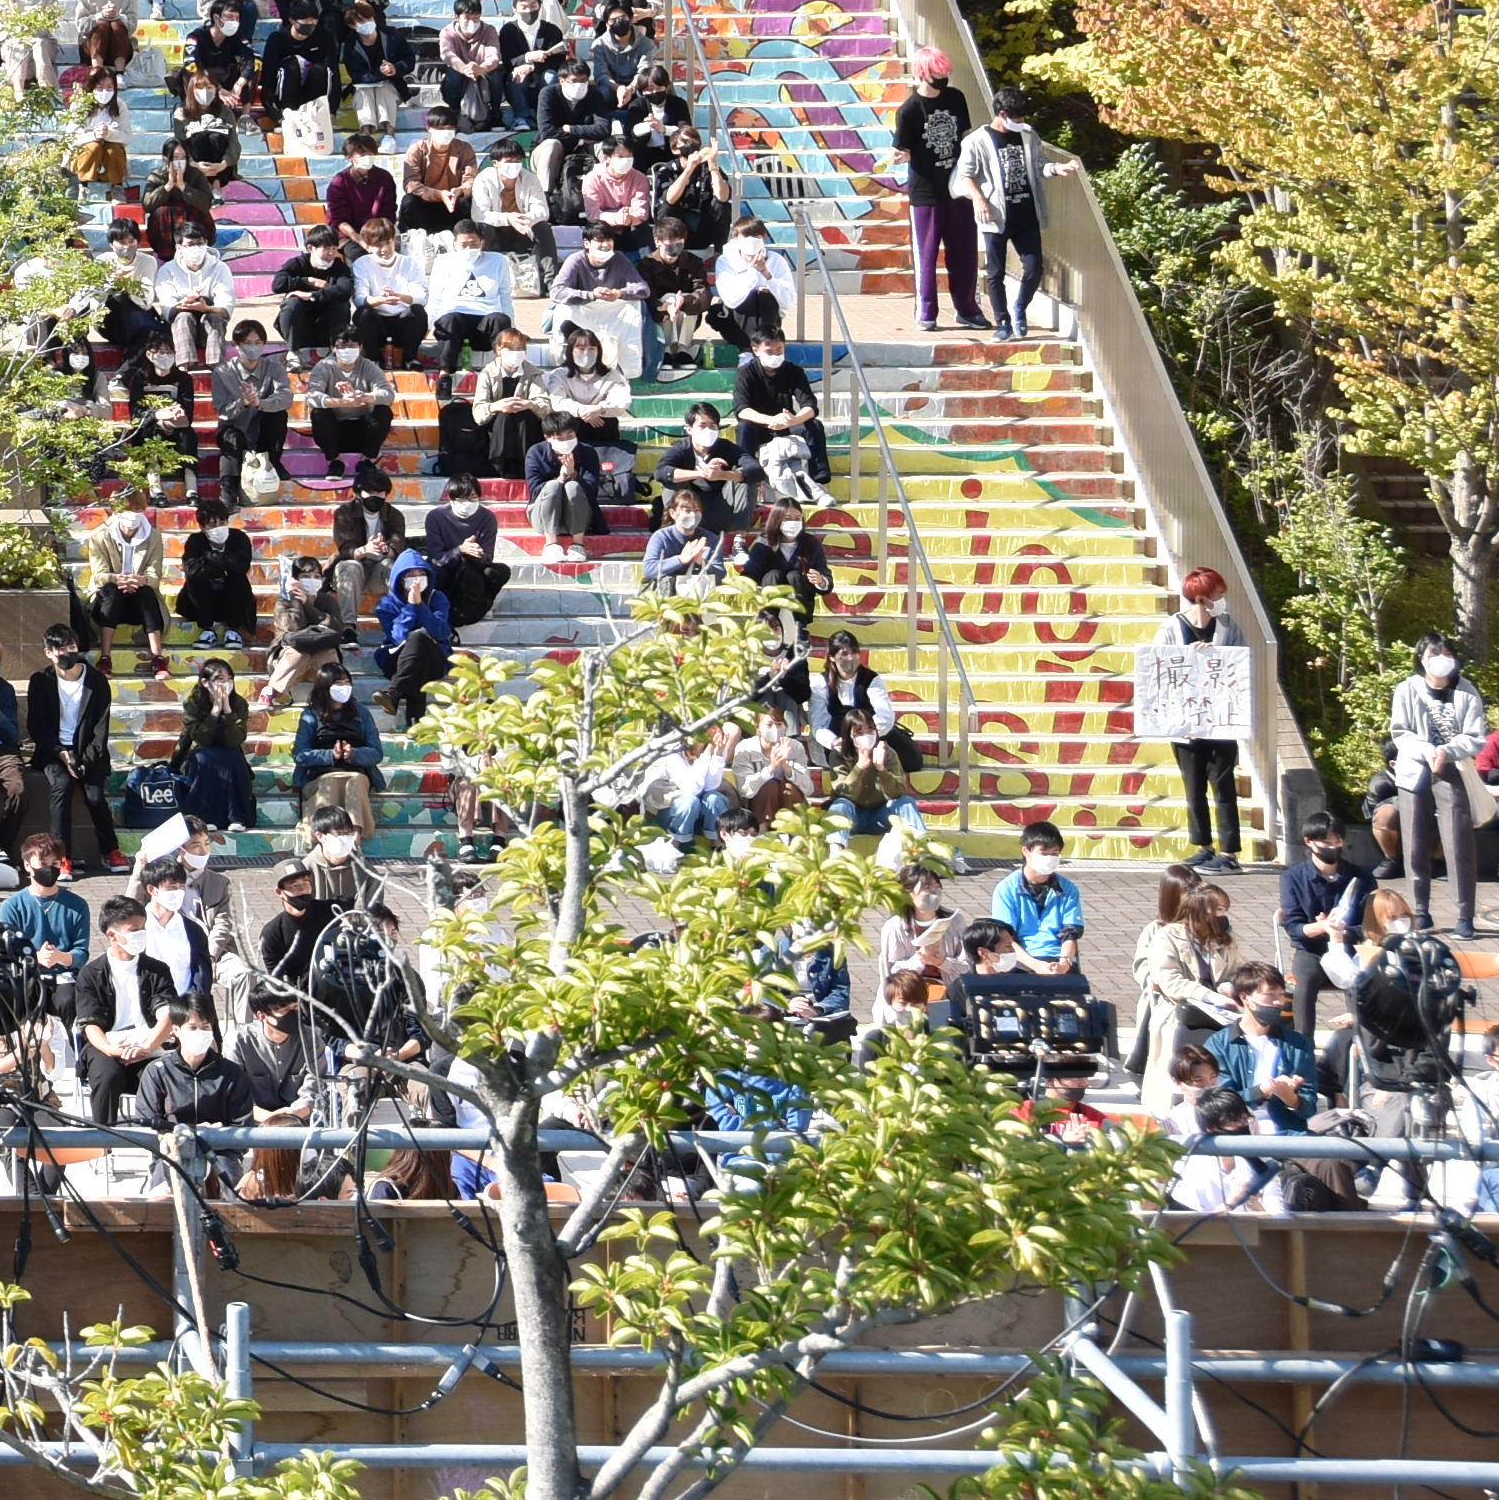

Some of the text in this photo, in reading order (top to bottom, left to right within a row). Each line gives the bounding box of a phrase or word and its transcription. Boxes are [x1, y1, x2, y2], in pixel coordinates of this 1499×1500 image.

[1151, 656, 1239, 690] 撮影
[1181, 696, 1249, 727] 禁止
[144, 786, 173, 803] Lee
